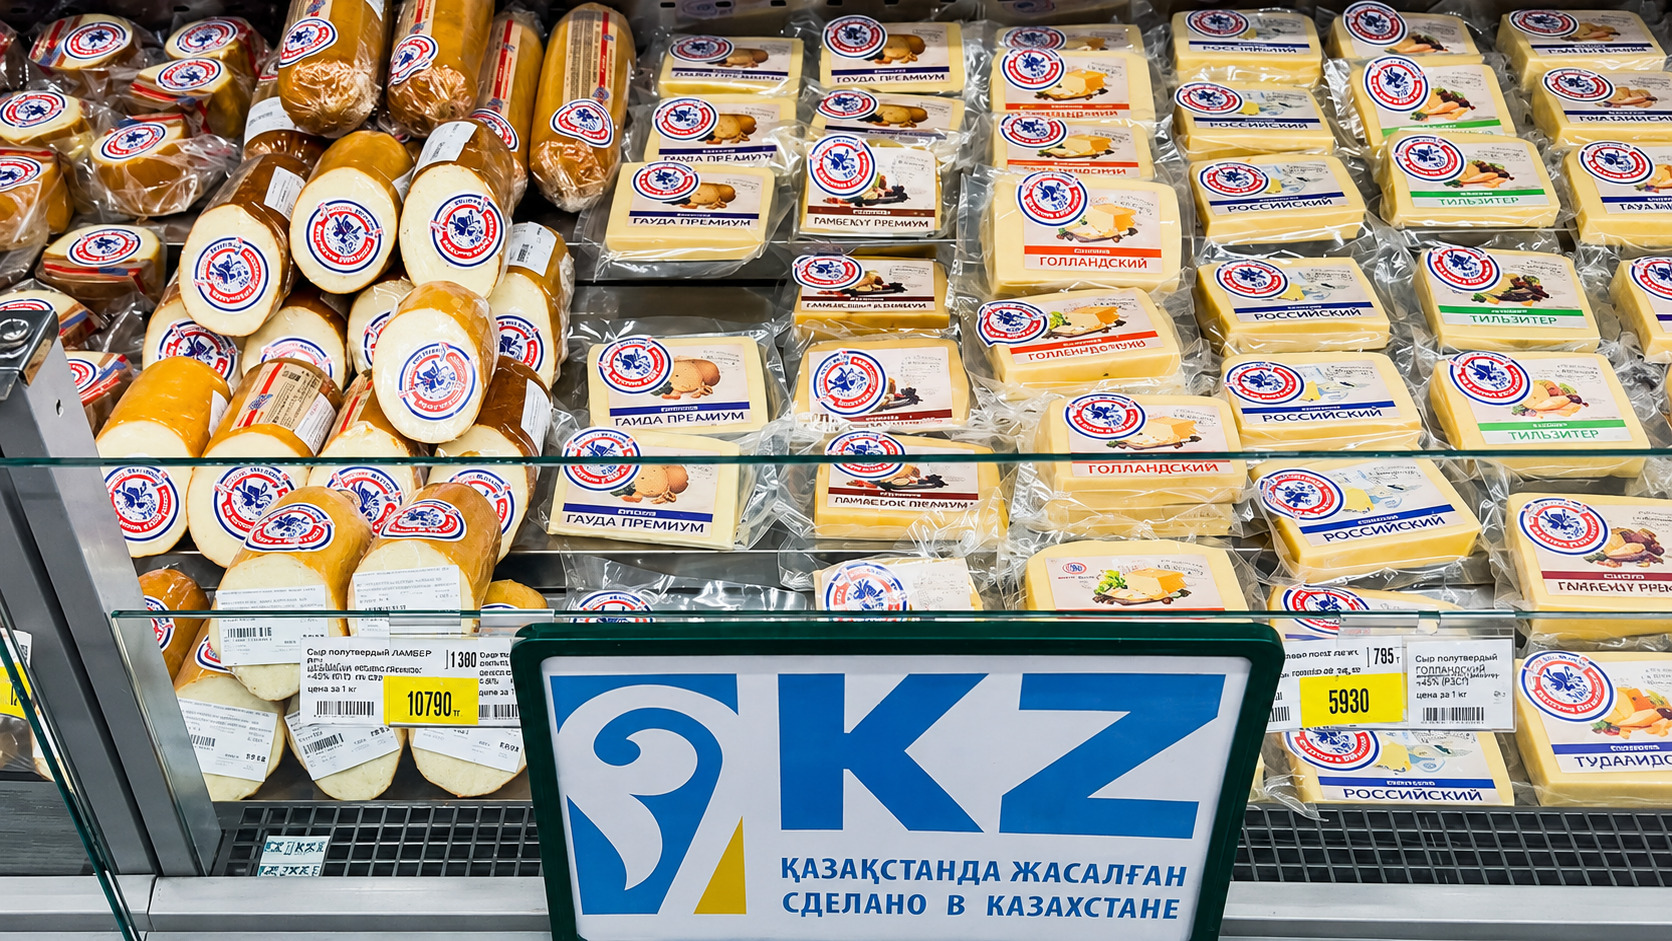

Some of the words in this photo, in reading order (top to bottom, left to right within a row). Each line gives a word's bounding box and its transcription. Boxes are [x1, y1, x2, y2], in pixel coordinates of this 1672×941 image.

[632, 217, 677, 226] ГАУДА
[1040, 256, 1148, 270] ГОЛЛАНДСКИЙ
[1088, 463, 1219, 475] ГОЛЛАНДСКИЙ
[566, 513, 617, 528] ГАУДА
[620, 517, 705, 534] ПРЕМИУМ
[1323, 514, 1446, 543] РОССИЙСКИЙ
[408, 691, 453, 717] 10790
[1329, 688, 1370, 715] 5930
[1452, 690, 1456, 698] 1
[778, 673, 1226, 839] KZ
[1343, 787, 1483, 801] РОССИЙСКИЙ
[781, 857, 1002, 886] ҚАЗАҚСТАНДА
[1011, 861, 1188, 888] ЖАСАЛҒАН
[782, 892, 927, 918] СДЕЛАНО
[947, 894, 966, 916] В
[986, 895, 1181, 921] КАЗАХСТАНЕ
